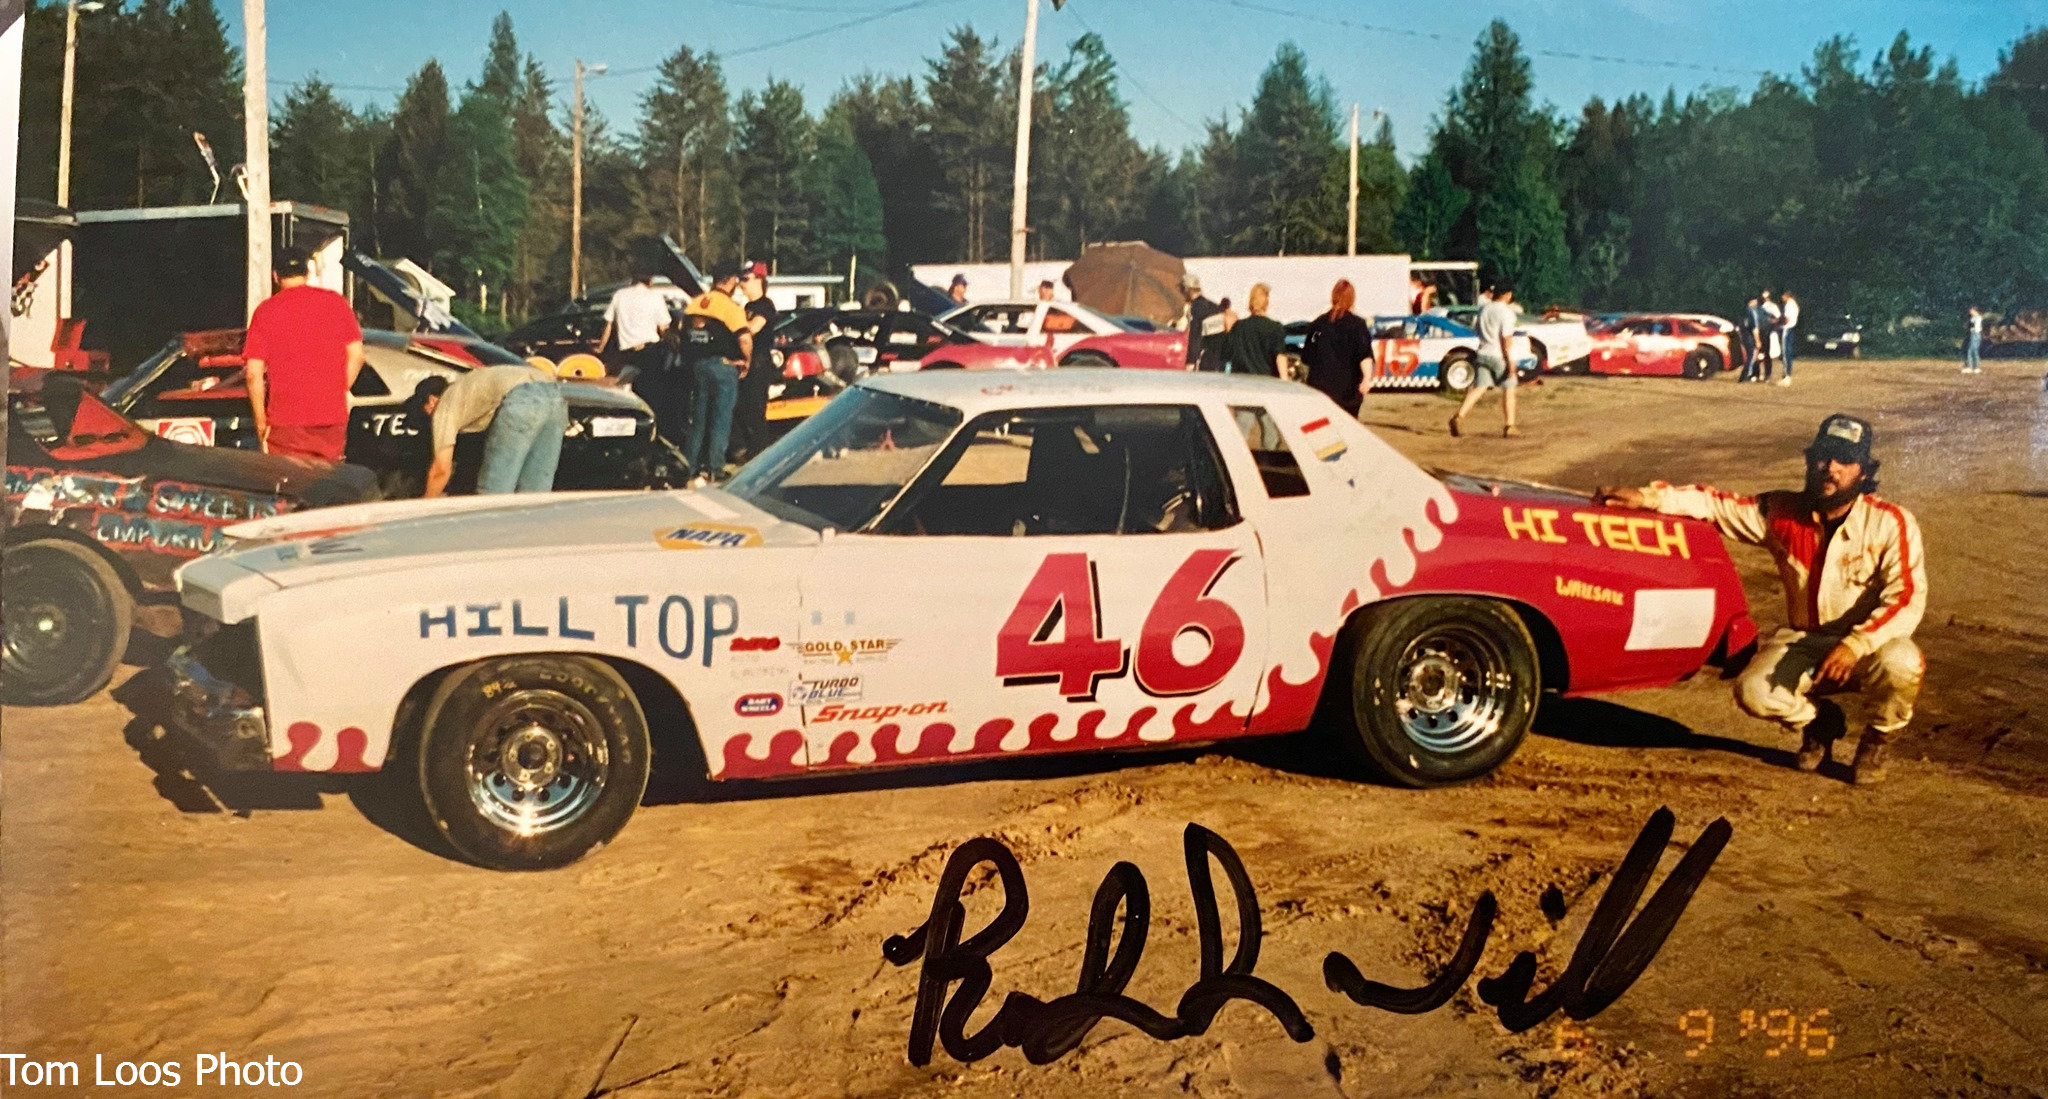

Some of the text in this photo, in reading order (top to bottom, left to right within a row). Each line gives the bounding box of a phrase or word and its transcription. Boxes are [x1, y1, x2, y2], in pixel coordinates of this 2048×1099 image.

[1372, 338, 1420, 377] 15
[667, 528, 746, 547] NAPA
[1503, 507, 1691, 560] HI TECH
[420, 594, 739, 668] HILL TOP
[995, 549, 1246, 703] 46
[805, 639, 885, 653] GOLD STAR
[811, 700, 948, 724] Snap-on
